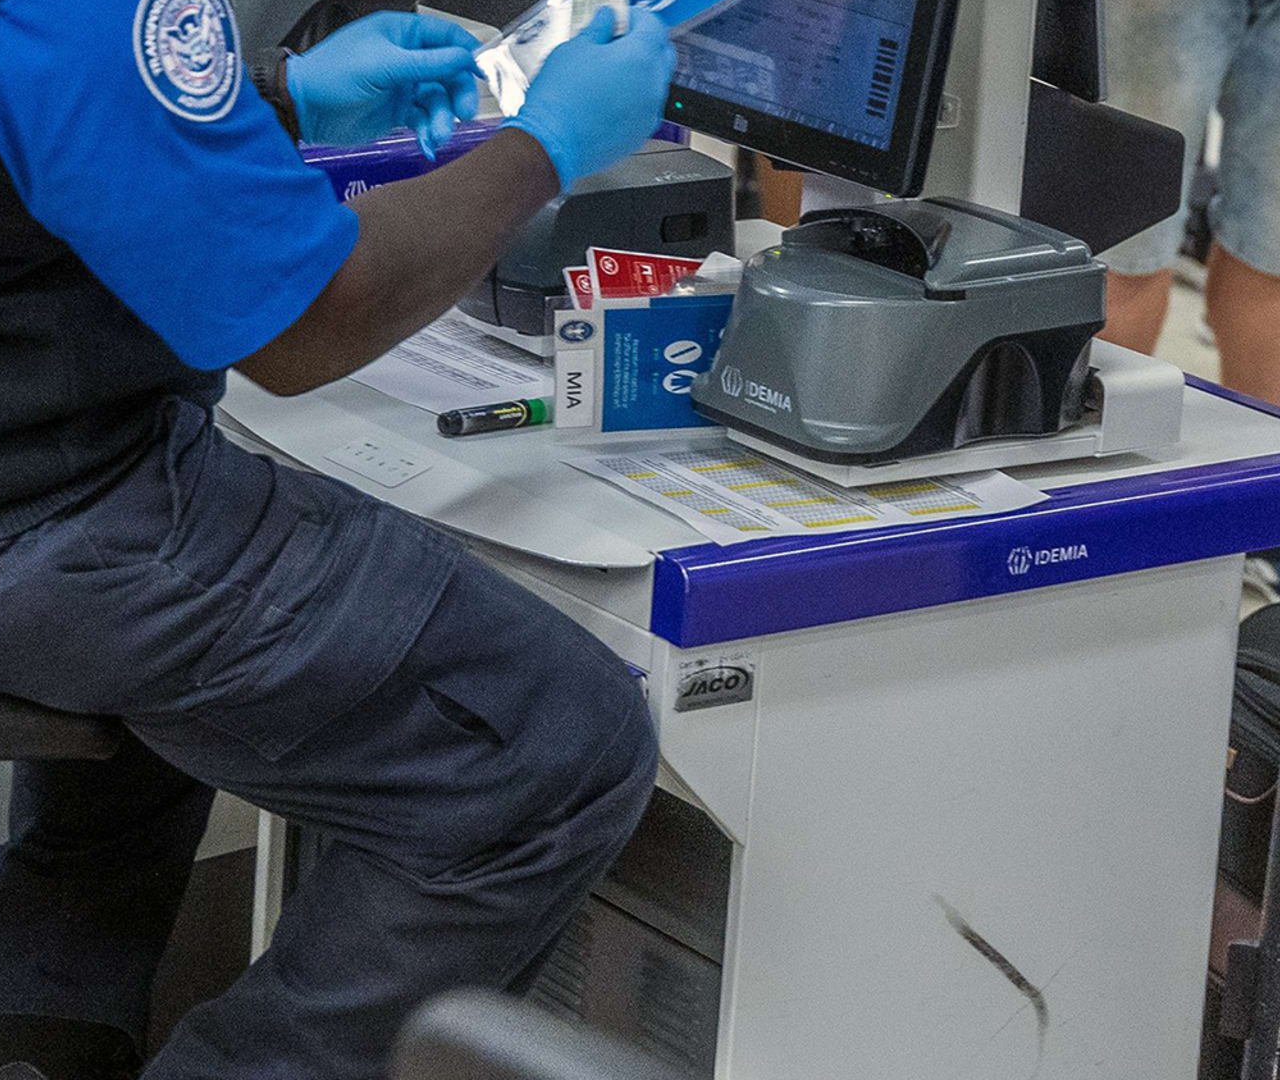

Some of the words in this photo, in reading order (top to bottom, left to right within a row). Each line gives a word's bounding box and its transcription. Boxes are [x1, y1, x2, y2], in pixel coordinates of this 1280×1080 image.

[566, 371, 582, 409] MIA
[745, 379, 792, 413] IDEMIA
[1034, 543, 1089, 566] IDEMIA
[682, 674, 740, 698] JACO
